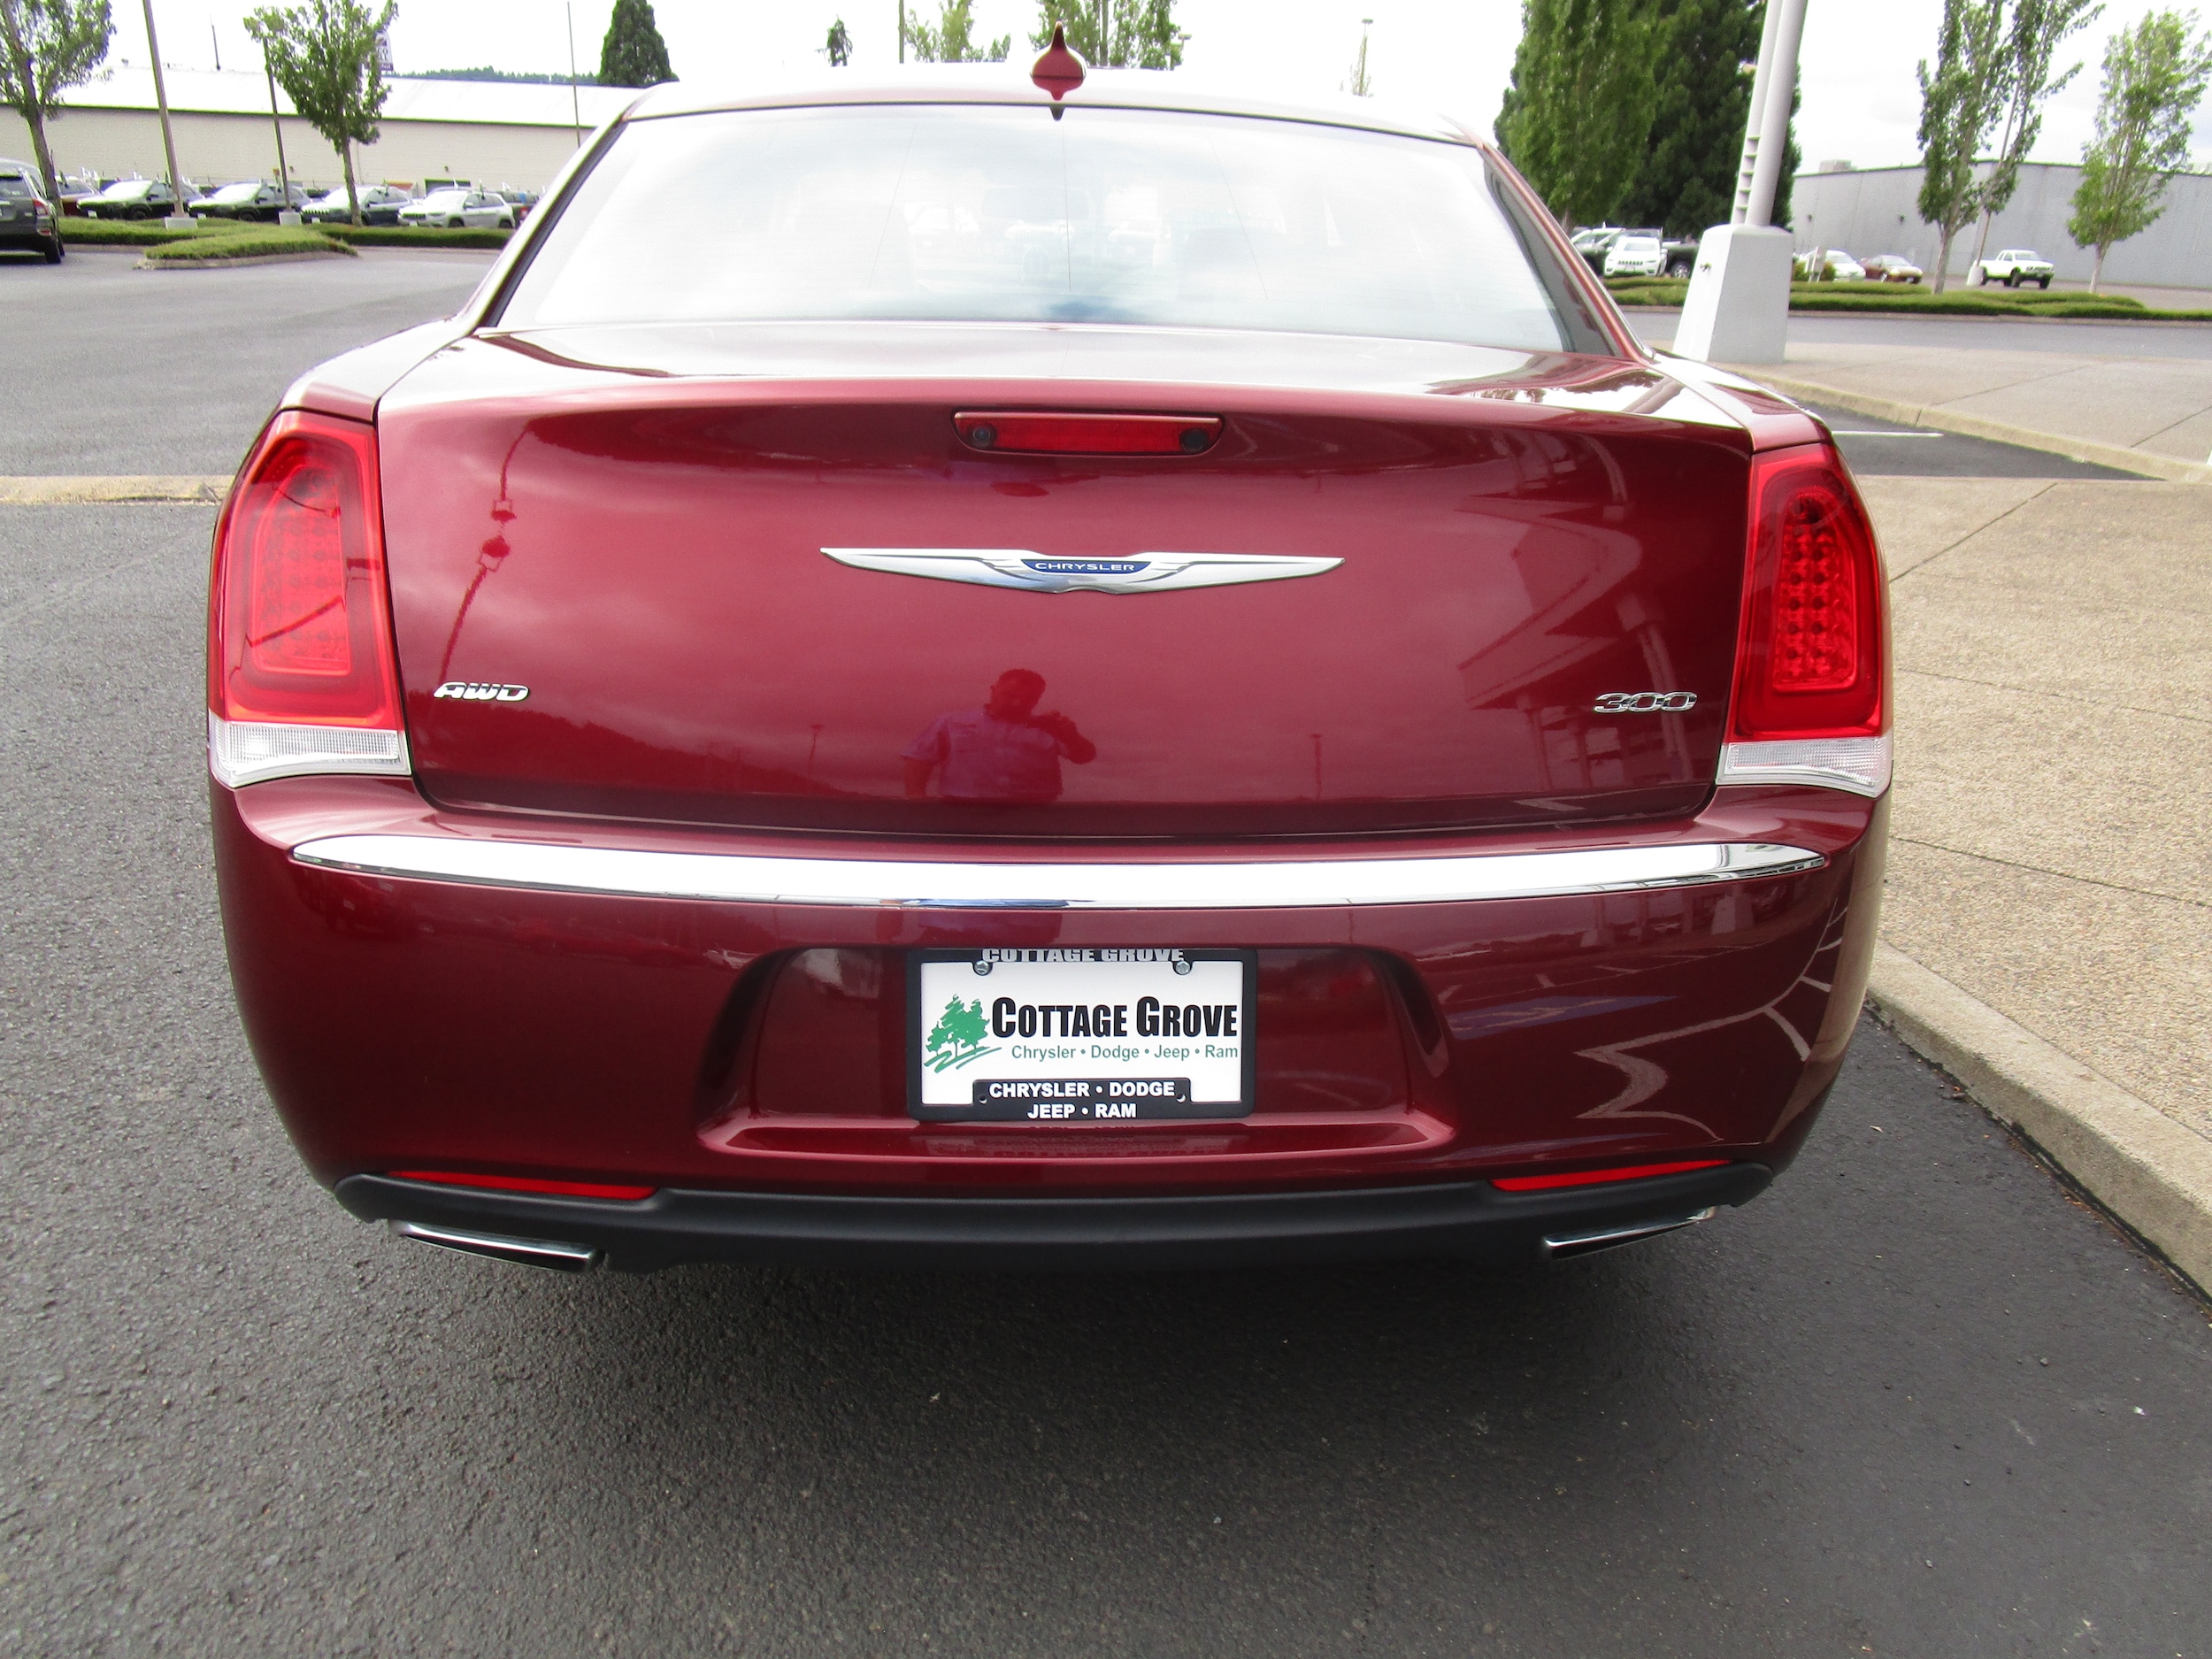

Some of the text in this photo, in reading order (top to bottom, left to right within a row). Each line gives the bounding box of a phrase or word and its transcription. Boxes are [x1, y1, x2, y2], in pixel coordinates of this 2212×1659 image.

[1034, 562, 1135, 572] CHRYSLER
[434, 681, 529, 702] AWD
[1594, 691, 1698, 713] 300
[982, 949, 1185, 963] COTTAGE GROVE
[1011, 1045, 1239, 1063] Chrysler Dodge Jeep Ram
[989, 1081, 1175, 1098] CHRYSLER DODGE
[1027, 1103, 1137, 1119] JEEP RAM
